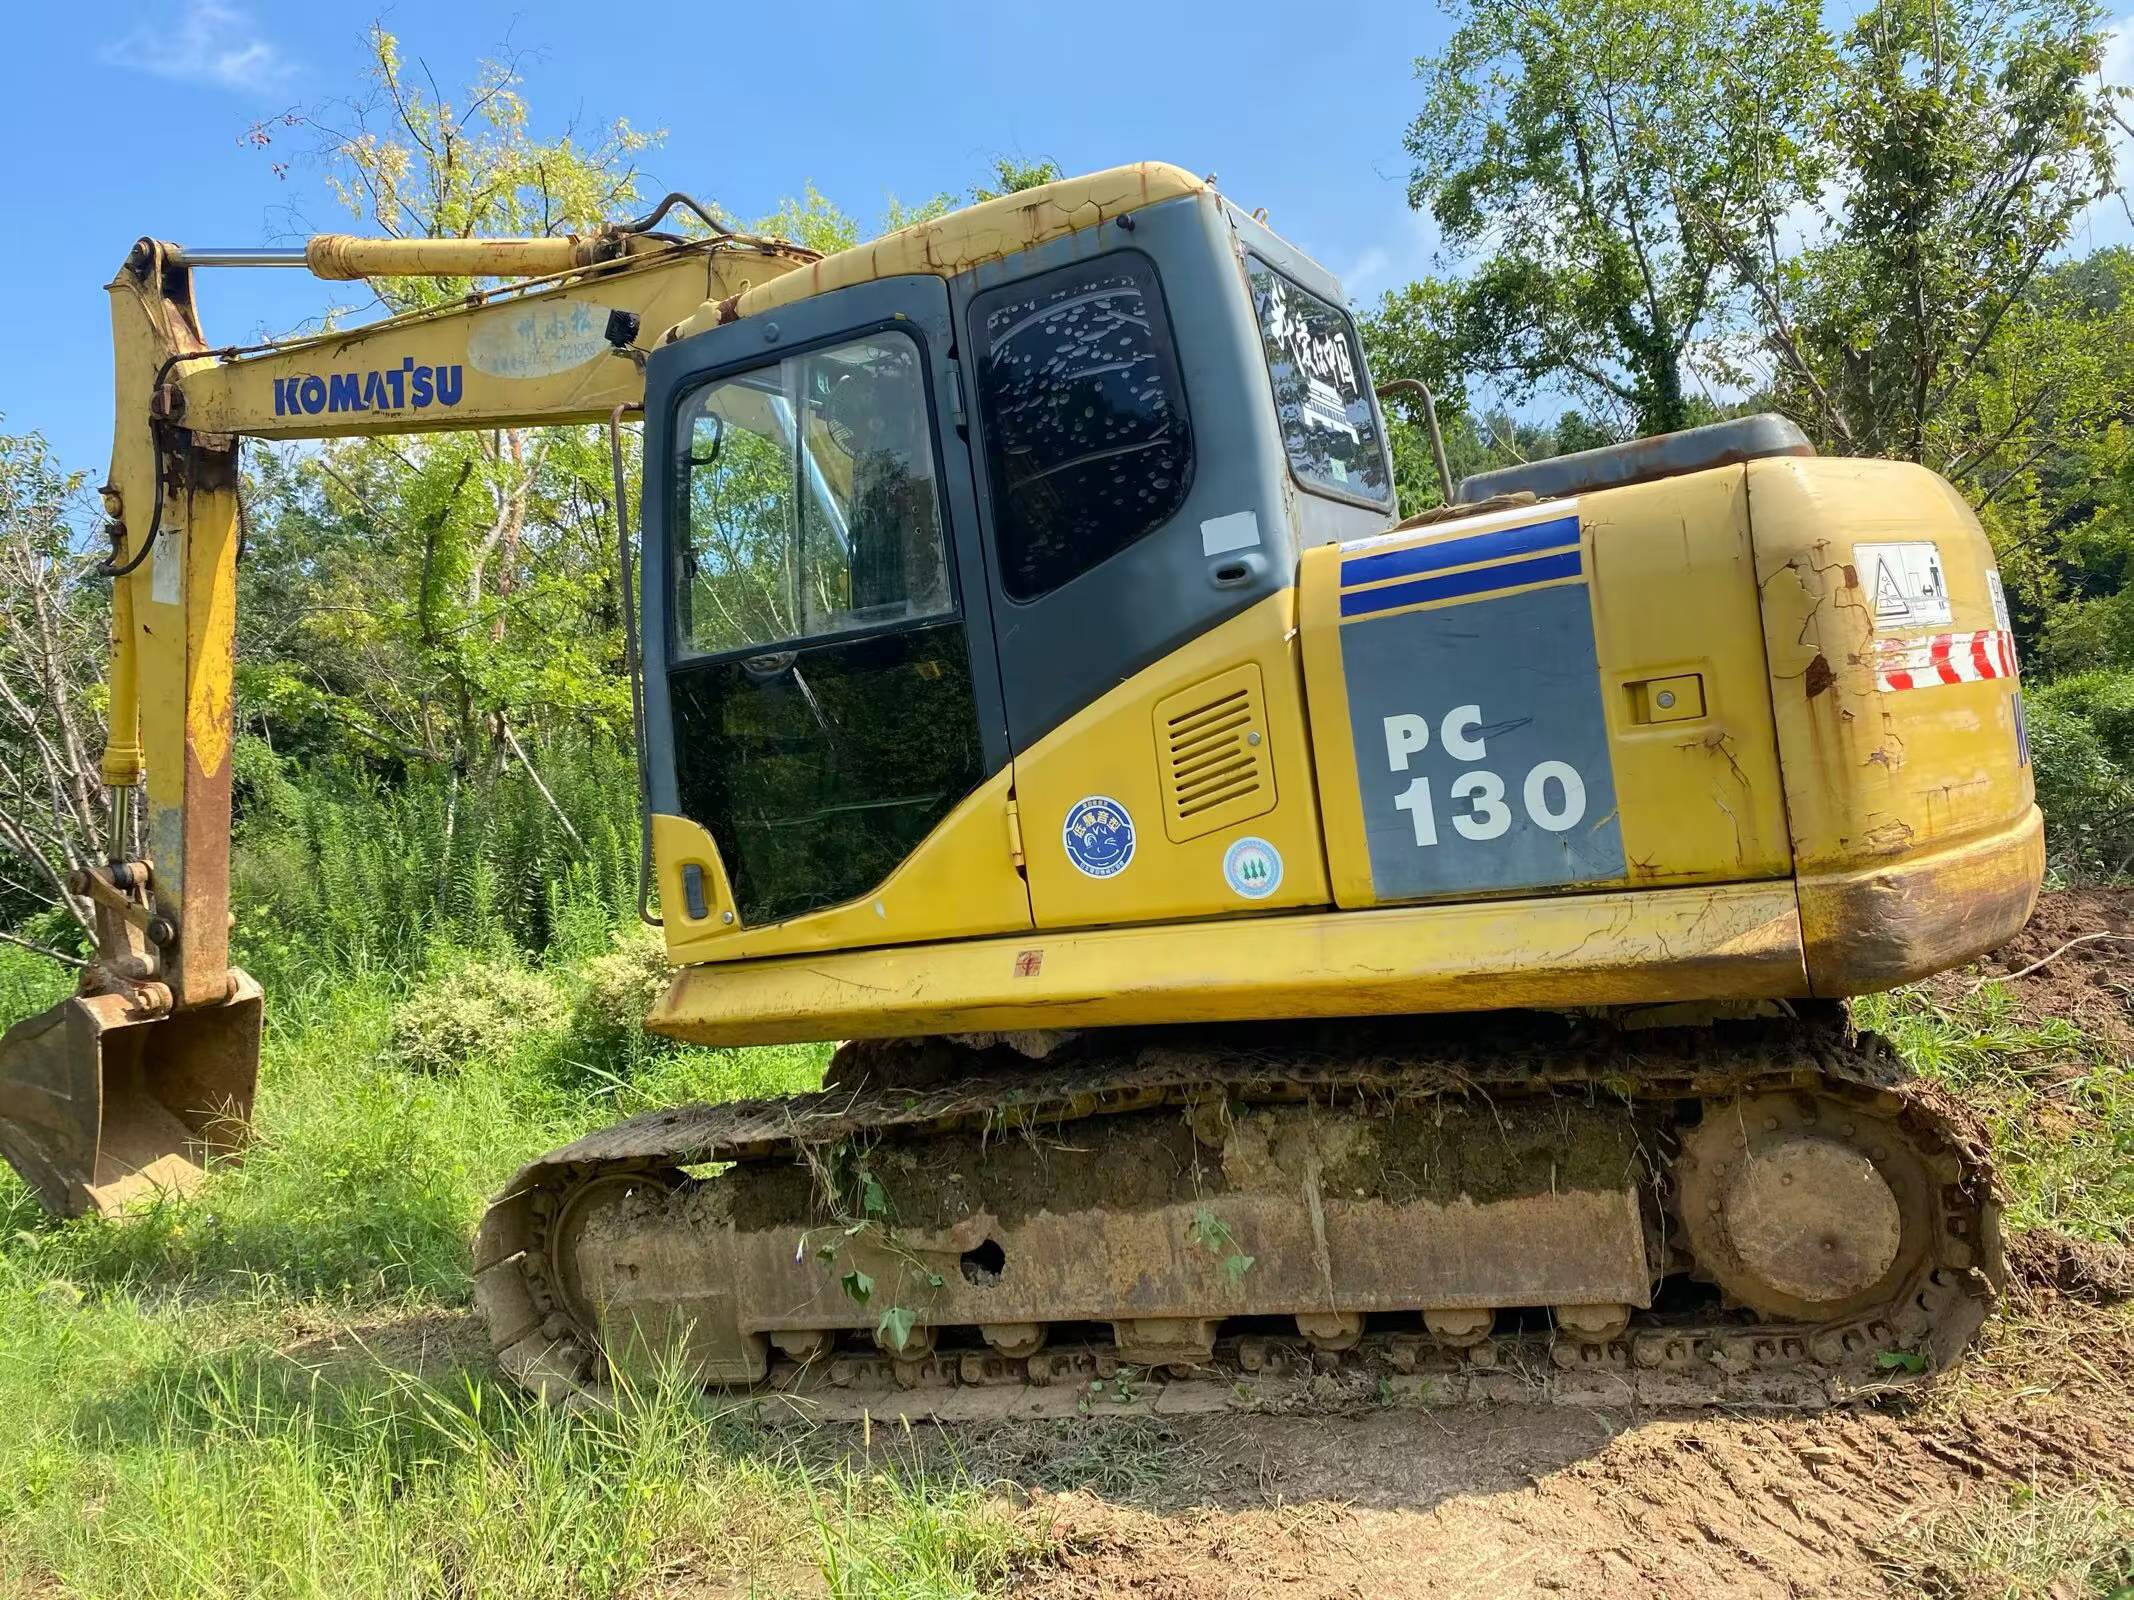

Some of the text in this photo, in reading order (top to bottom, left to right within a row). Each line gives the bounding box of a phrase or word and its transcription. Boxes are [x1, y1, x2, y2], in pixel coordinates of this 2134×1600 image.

[1270, 276, 1358, 395] 我爱你中国
[274, 356, 463, 416] KOMATSU
[1384, 704, 1487, 772] PC
[1394, 760, 1587, 847] 130
